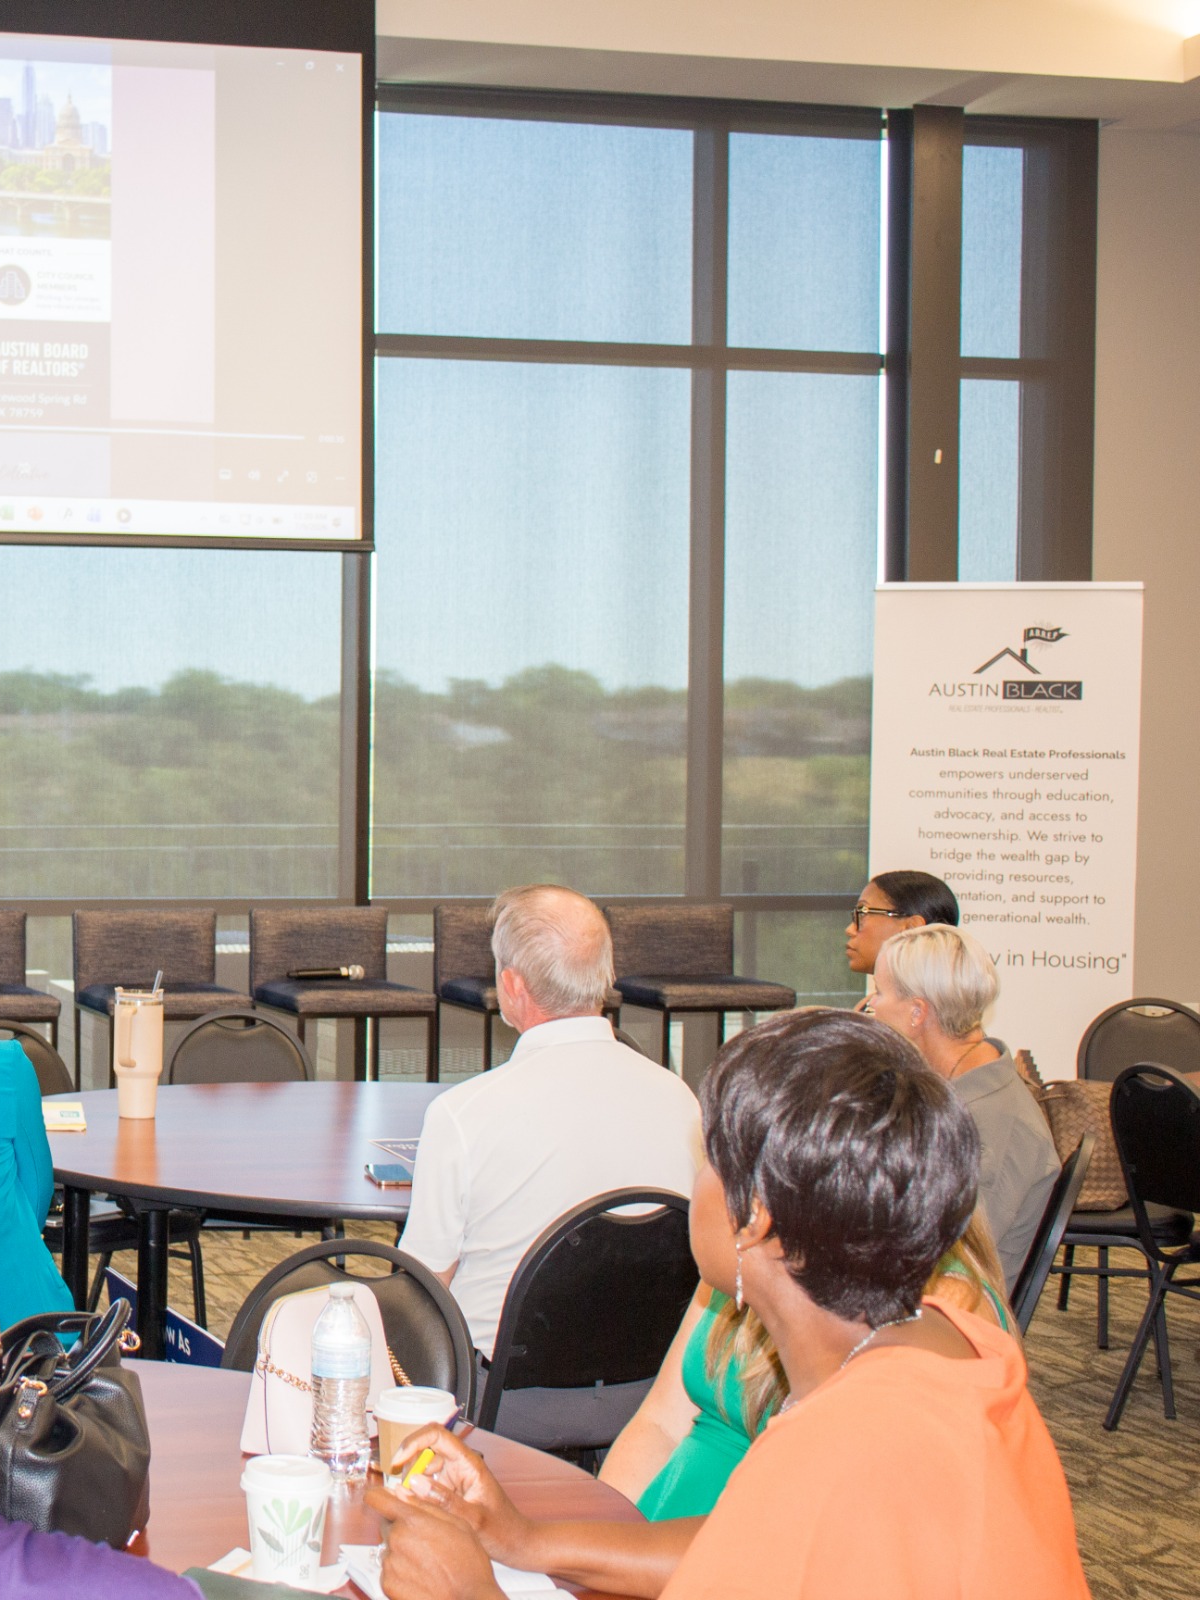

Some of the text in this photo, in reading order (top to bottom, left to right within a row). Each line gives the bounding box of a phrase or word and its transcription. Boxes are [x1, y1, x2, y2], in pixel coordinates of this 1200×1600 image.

[43, 342, 89, 359] BOARD
[38, 393, 71, 406] Spring
[73, 394, 87, 405] Rd
[9, 407, 44, 418] 78759
[928, 682, 1079, 699] AUSTIN BLACK
[910, 748, 1126, 760] Austin Black Real Estate Professionals
[939, 769, 1089, 782] empowers underserved
[908, 788, 1115, 804] communities through education,
[934, 808, 1088, 822] advocacy, and access to
[918, 828, 1103, 843] homeownership. We strive to
[930, 848, 1090, 866] bridge the wealth gap by
[943, 870, 1074, 885] providing resources,
[1011, 893, 1035, 904] and
[1039, 893, 1089, 906] support
[1093, 895, 1106, 905] to
[962, 912, 1090, 926] generational wealth.
[1007, 949, 1024, 967] in
